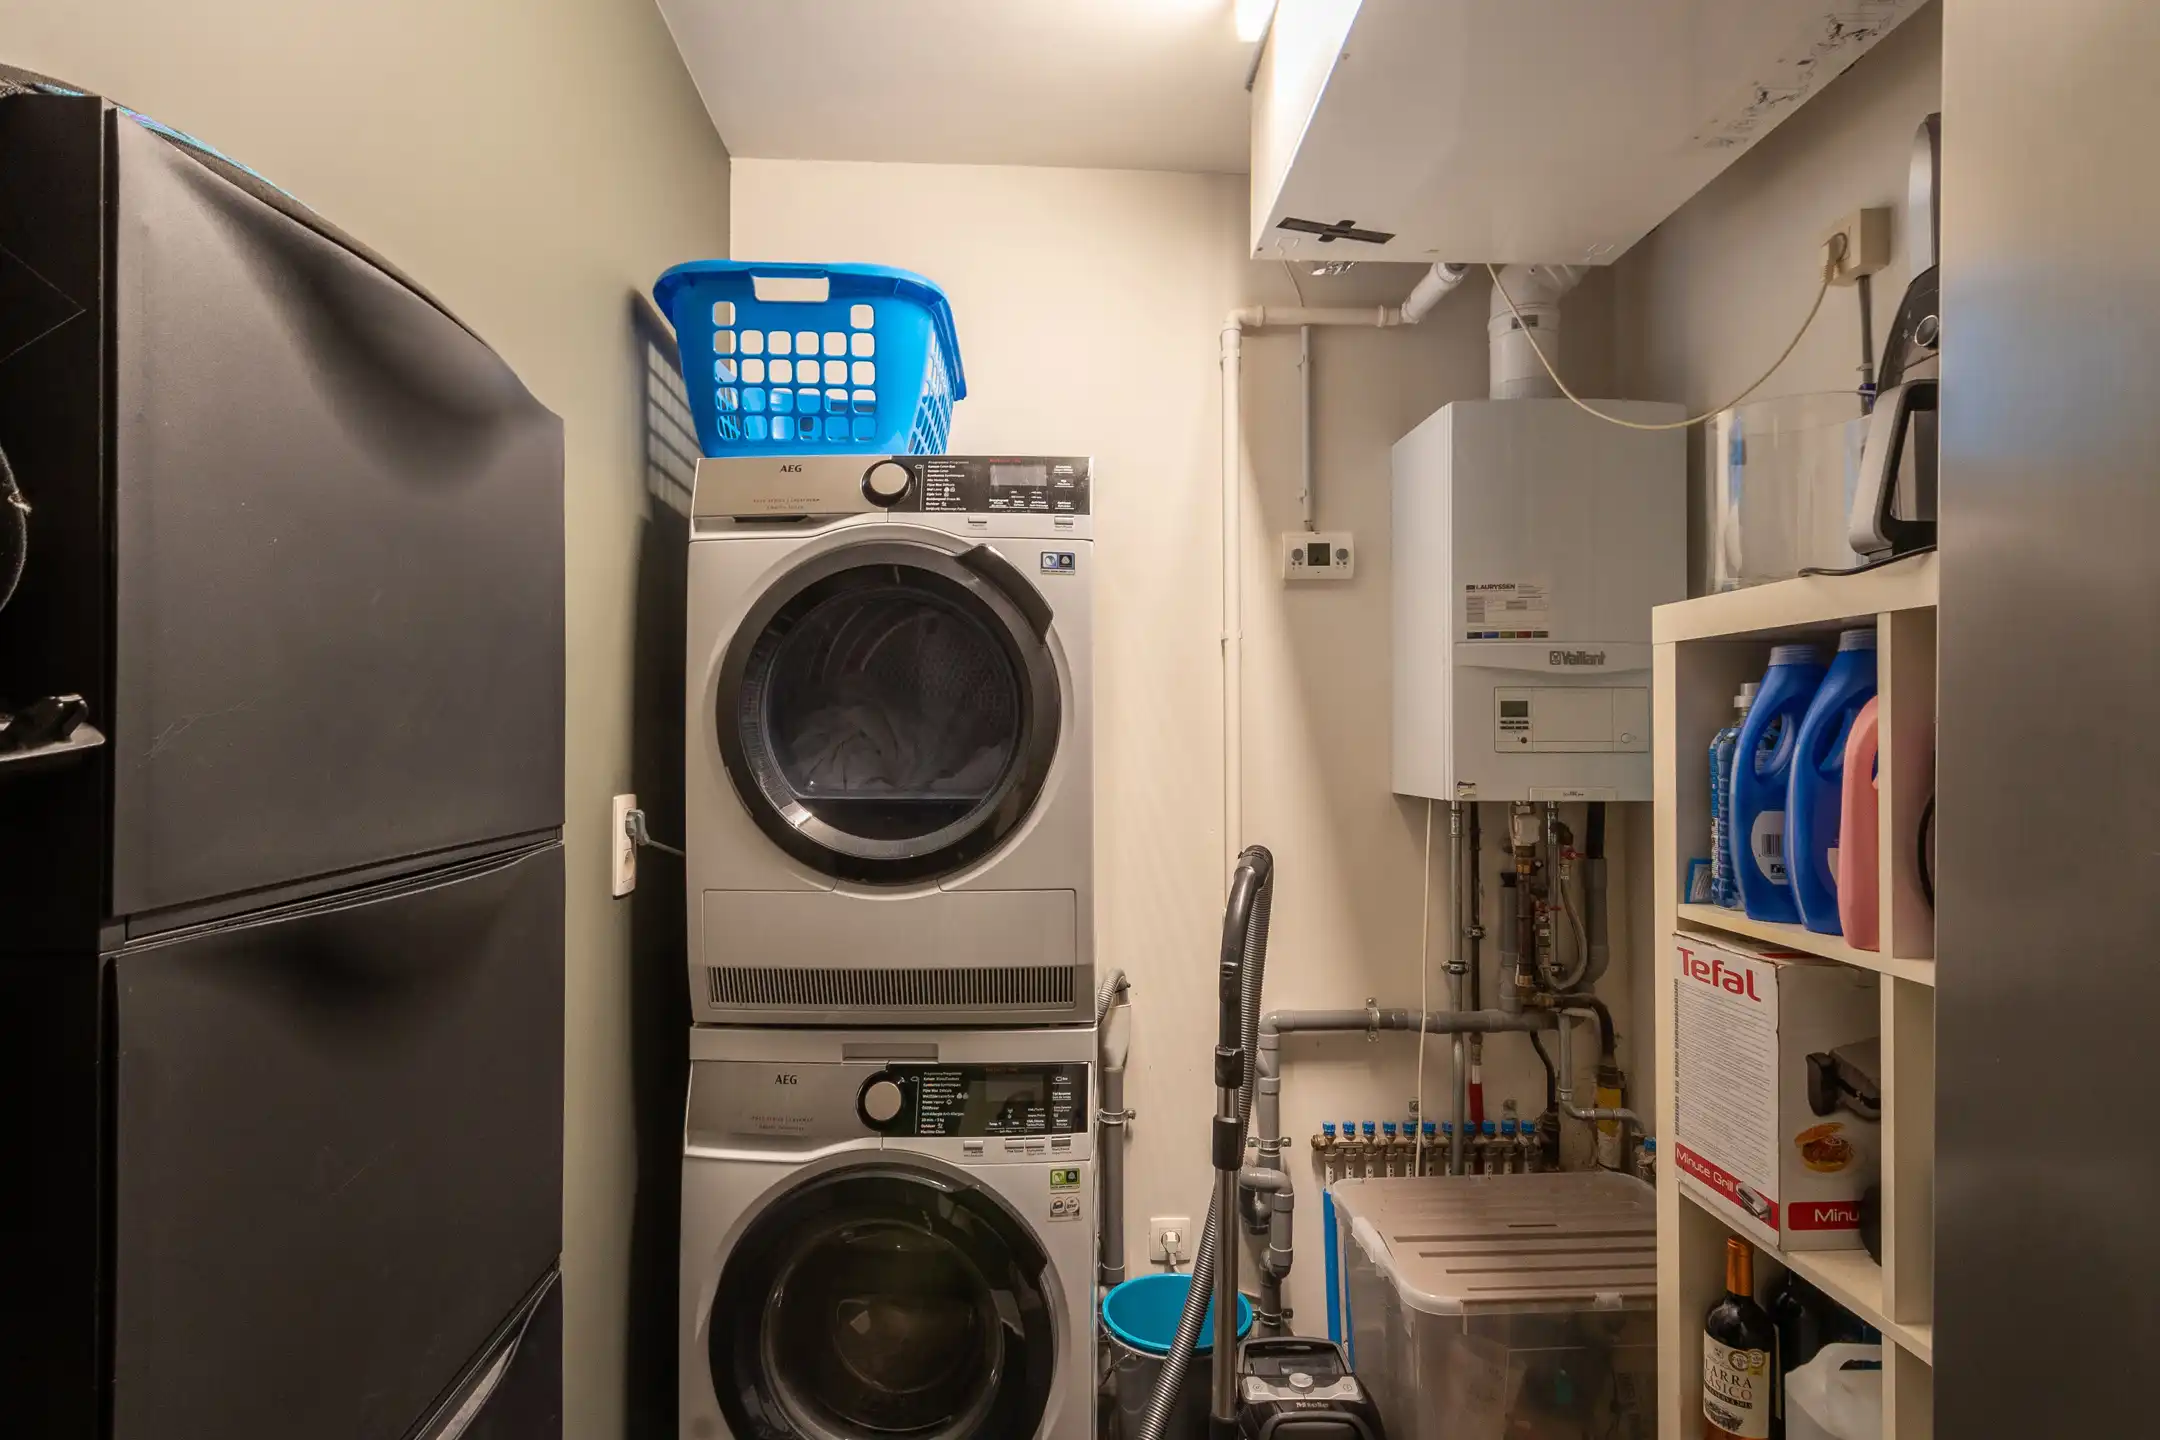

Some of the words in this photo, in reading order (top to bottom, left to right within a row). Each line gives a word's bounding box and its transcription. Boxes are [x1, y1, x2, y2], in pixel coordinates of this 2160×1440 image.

[780, 464, 802, 473] AEG
[1562, 651, 1605, 665] Vaillant
[1677, 946, 1761, 1002] Tefal
[775, 1074, 797, 1085] AEG
[1676, 1148, 1711, 1178] Minute
[1713, 1172, 1734, 1193] Grill
[1814, 1208, 1860, 1222] Minu
